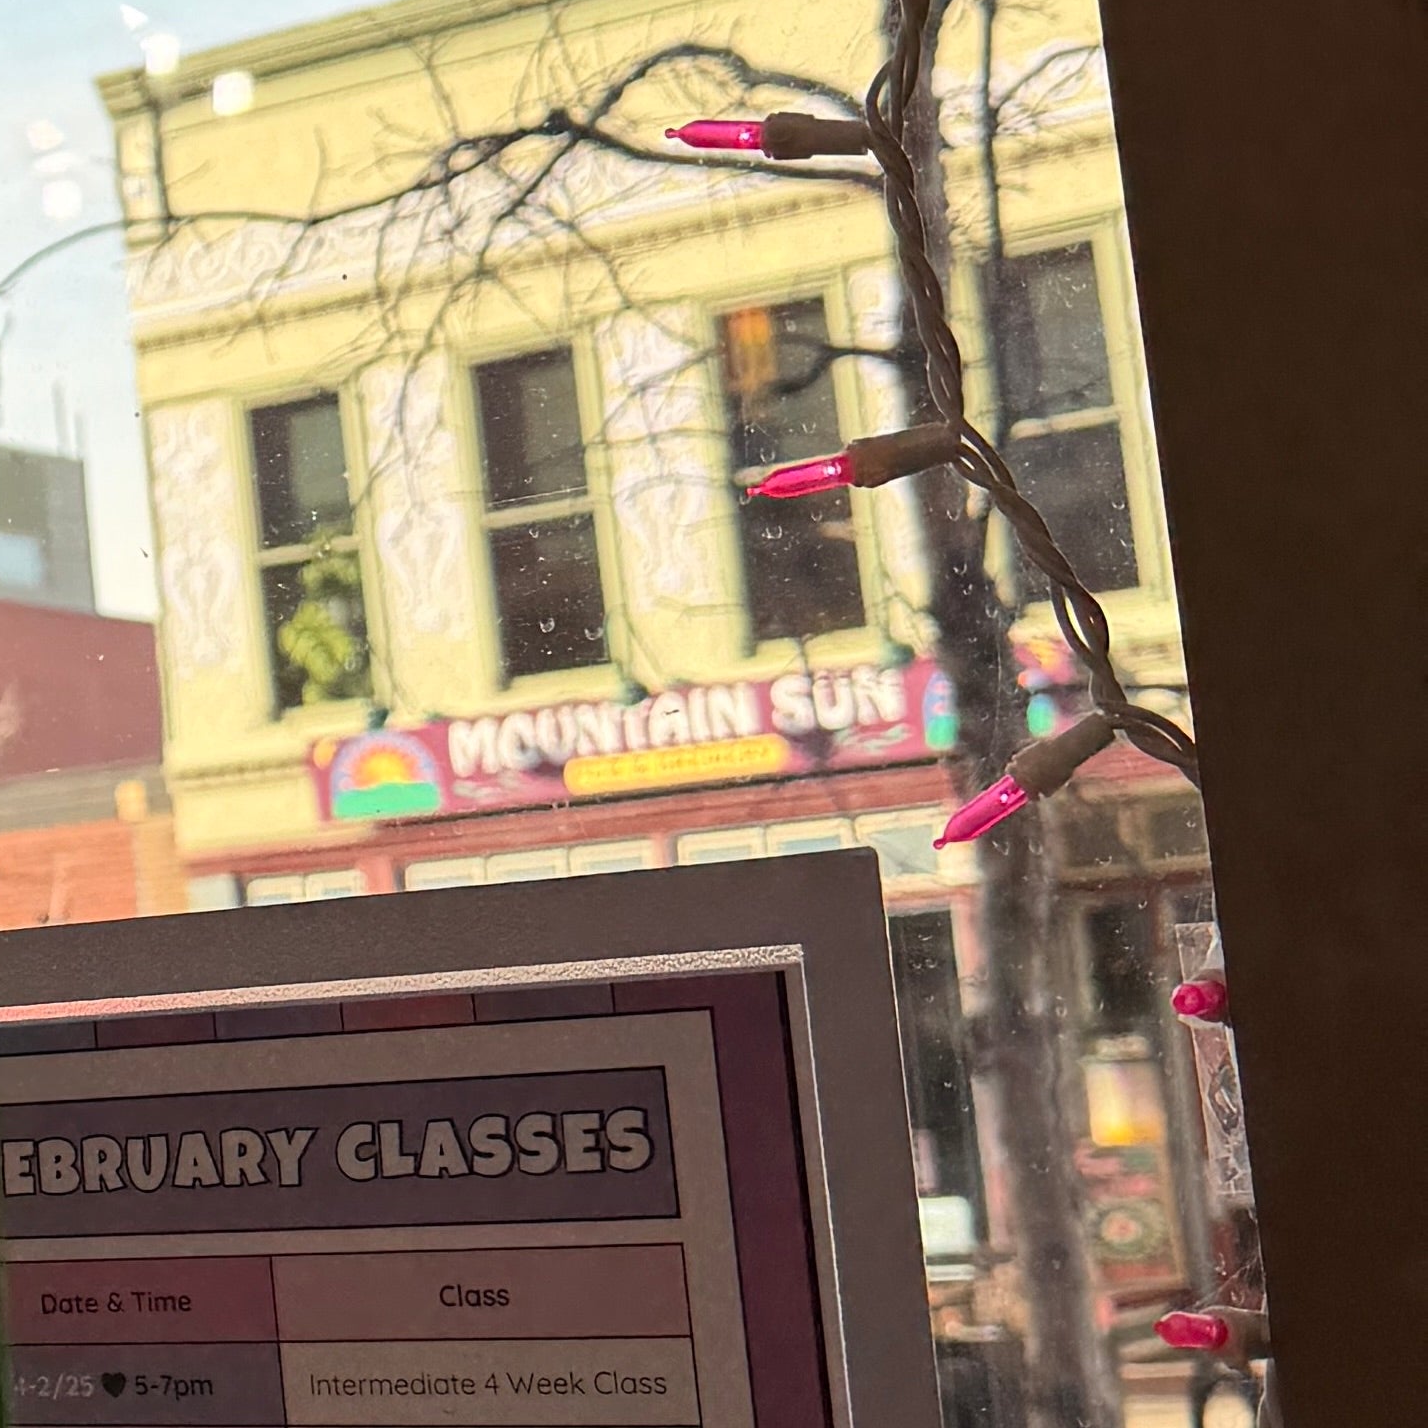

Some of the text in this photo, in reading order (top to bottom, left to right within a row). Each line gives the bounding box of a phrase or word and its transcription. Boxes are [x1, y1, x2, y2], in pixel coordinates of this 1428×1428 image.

[447, 682, 761, 778] MOUNTAIN
[771, 667, 907, 733] SUN
[334, 1107, 655, 1185] CLASSES
[41, 1291, 192, 1315] Date & Time
[438, 1284, 511, 1308] Class
[135, 1375, 214, 1402] 5-7pm
[309, 1370, 668, 1398] Intermediate 4 Week Class
